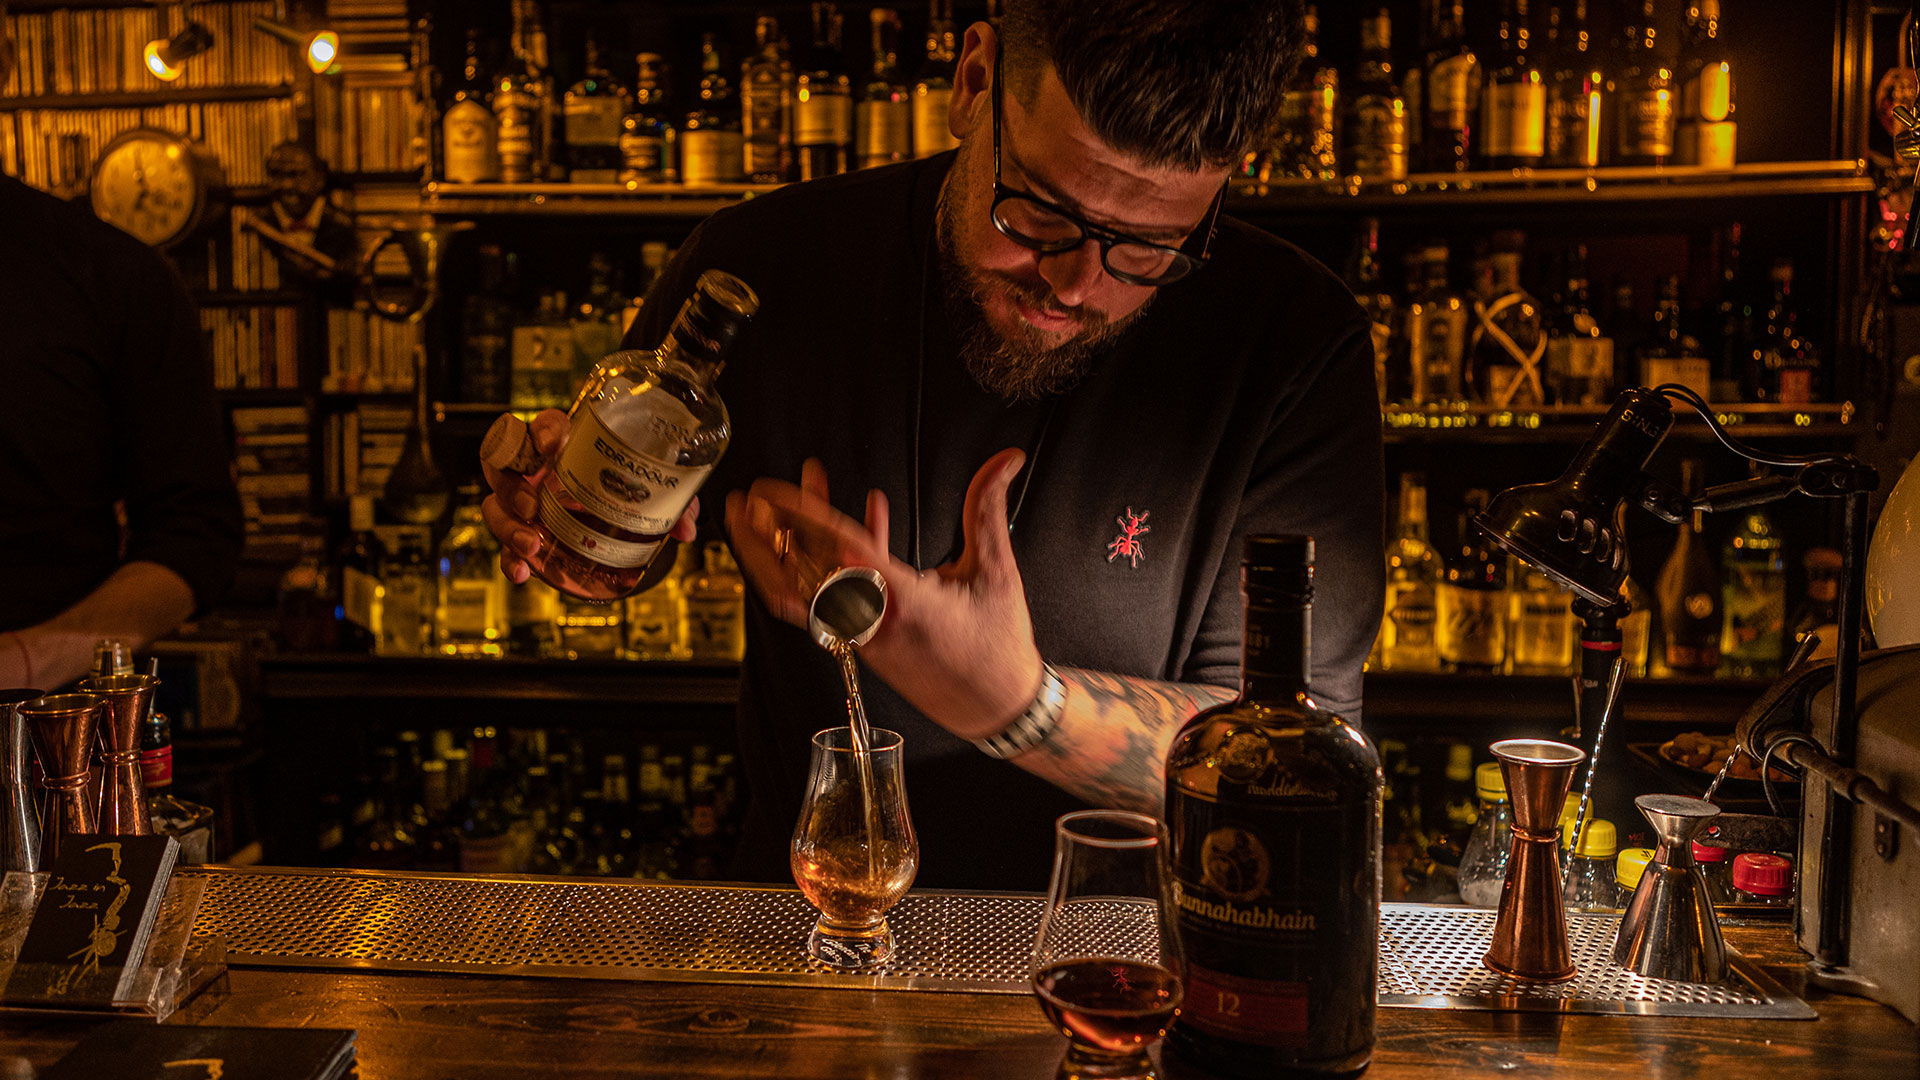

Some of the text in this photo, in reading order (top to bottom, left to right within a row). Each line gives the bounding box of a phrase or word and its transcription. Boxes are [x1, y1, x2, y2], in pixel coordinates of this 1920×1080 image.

[594, 437, 680, 489] EDRADOUR
[1171, 880, 1316, 931] Bunnahabhain
[1216, 992, 1241, 1017] 12
